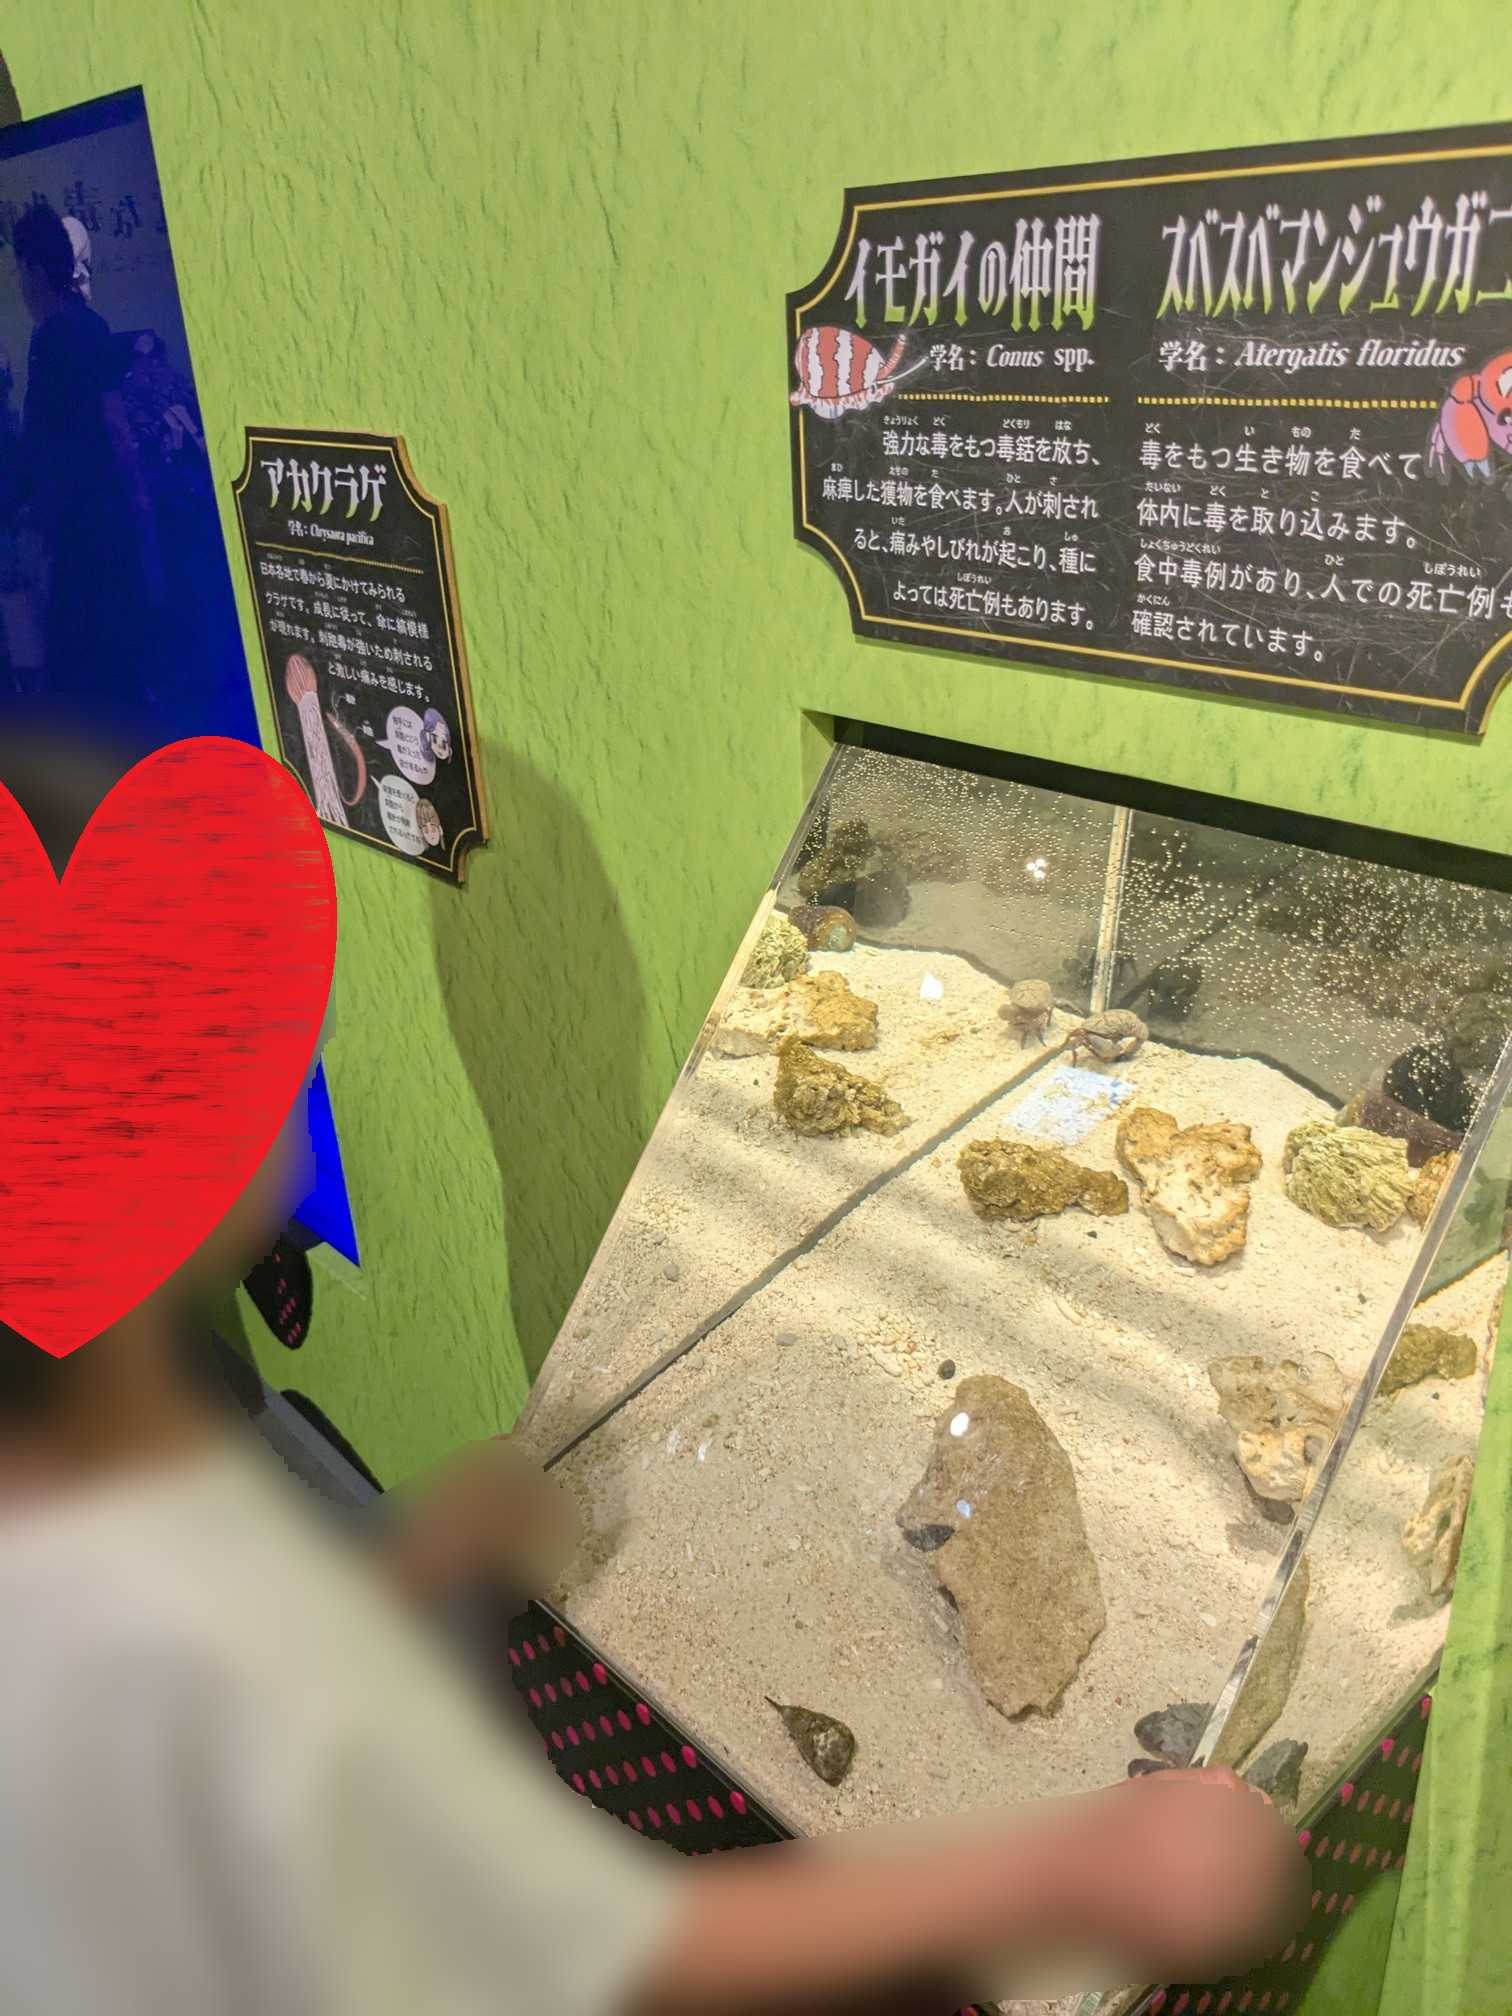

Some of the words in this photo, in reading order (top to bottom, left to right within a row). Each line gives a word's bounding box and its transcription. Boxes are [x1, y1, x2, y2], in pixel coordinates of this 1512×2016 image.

[844, 213, 1101, 333] イモガイの仲間
[987, 344, 1044, 367] Conus
[1053, 347, 1096, 373] spp.
[1233, 340, 1349, 375] Atergatis
[1355, 338, 1467, 369] floridus
[882, 429, 1100, 465] 強力な毒をもつ毒銛を放ち、
[1139, 439, 1422, 480] 毒をもつ生き物を食べて
[260, 458, 387, 521] アカクラゲ
[822, 475, 1099, 519] 麻痺した獲物を食べます。人が刺され
[1136, 497, 1416, 549] 体内に毒を取り込みます。
[853, 528, 1097, 575] ると、痛みやしびれが起こり、種に
[893, 580, 1094, 631] よっては死亡例もあります。
[1131, 609, 1325, 662] 確認されています。
